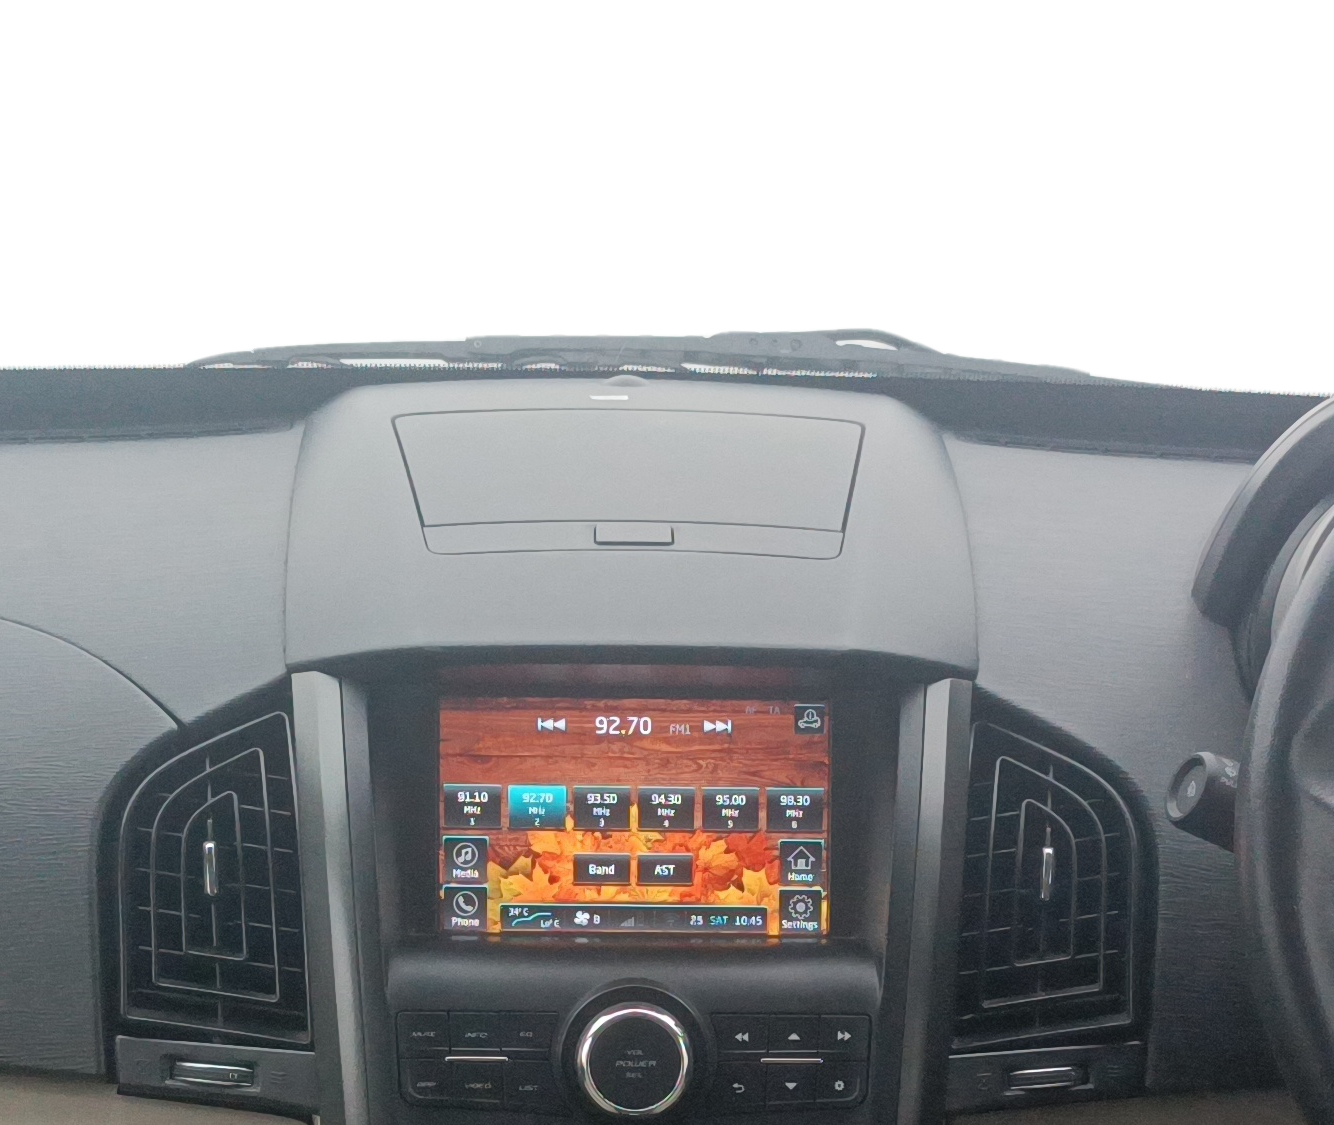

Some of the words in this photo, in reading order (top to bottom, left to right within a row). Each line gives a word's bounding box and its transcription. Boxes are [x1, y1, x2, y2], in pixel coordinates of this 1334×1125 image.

[595, 716, 652, 735] 92.70
[669, 723, 691, 735] FM1
[457, 791, 489, 803] 91.10
[522, 792, 554, 803] 92.70
[586, 793, 618, 804] 93.50
[651, 794, 682, 805] 94.30
[715, 794, 747, 806] 95.00
[463, 805, 481, 815] MHz
[528, 806, 545, 816] MHz
[593, 807, 610, 816] MHz
[657, 808, 675, 817] MHz
[722, 808, 740, 818] MHz
[786, 809, 804, 818] MHz
[534, 818, 540, 827] 2
[452, 868, 479, 879] Media
[588, 863, 615, 876] Band
[654, 864, 676, 876] AST
[787, 872, 814, 882] Home
[451, 916, 480, 927] Phone
[708, 915, 729, 926] SAT
[781, 919, 819, 931] Settings
[615, 1060, 657, 1068] POWER
[518, 1084, 539, 1092] LIST
